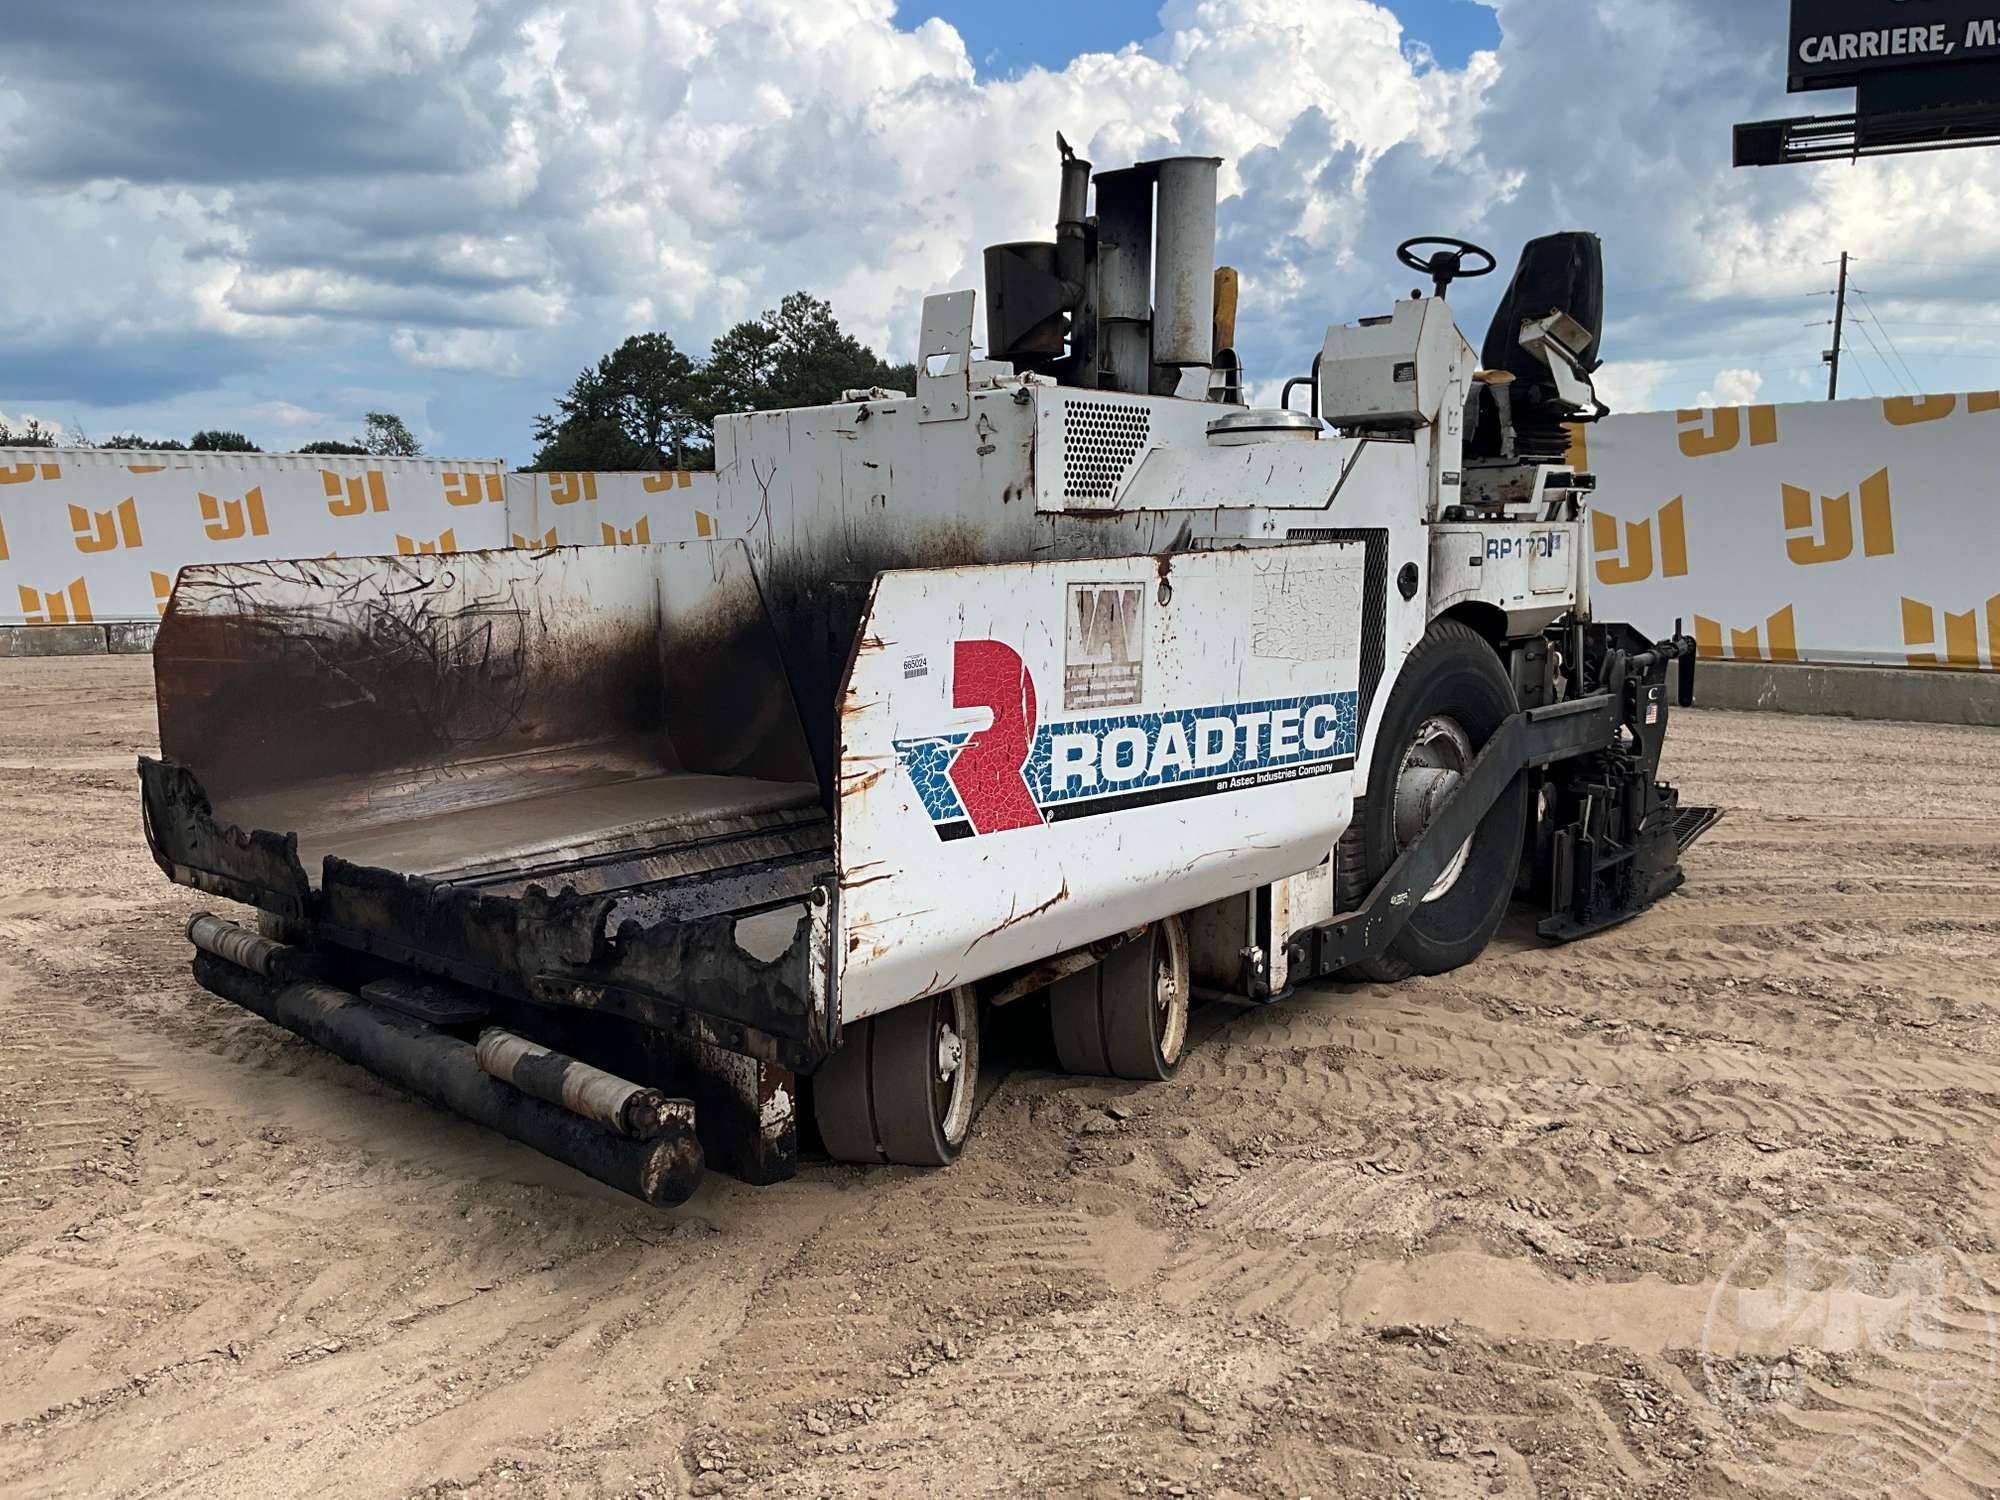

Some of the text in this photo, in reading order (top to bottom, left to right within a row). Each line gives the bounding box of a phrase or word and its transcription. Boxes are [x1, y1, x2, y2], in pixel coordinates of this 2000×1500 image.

[1799, 19, 2000, 64] CARRIERE, M
[903, 657, 927, 670] 665024
[1051, 703, 1337, 792] ROADTEC
[1216, 763, 1333, 791] an Astec Industries Company
